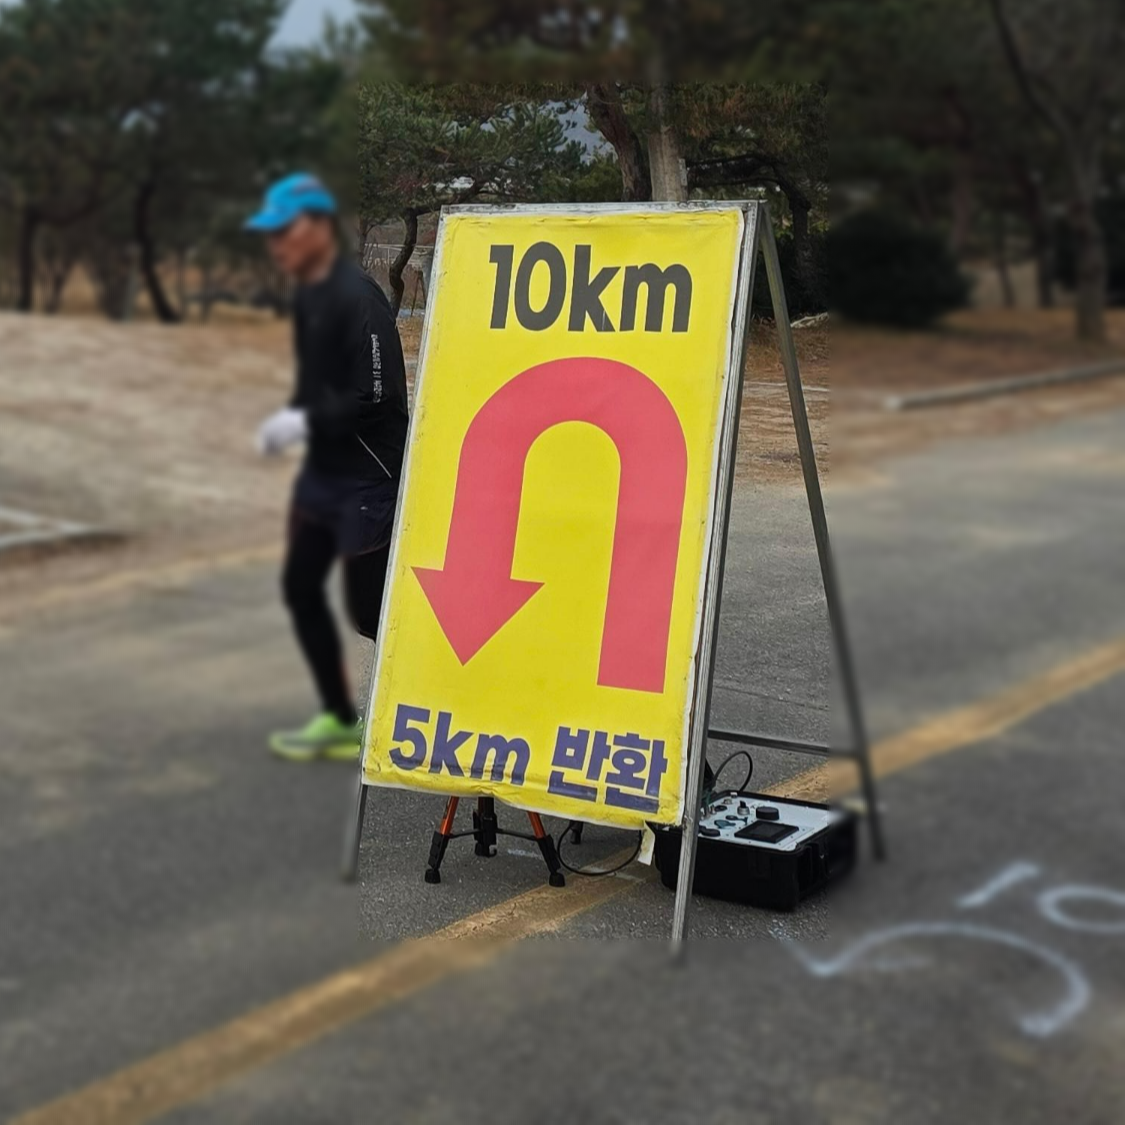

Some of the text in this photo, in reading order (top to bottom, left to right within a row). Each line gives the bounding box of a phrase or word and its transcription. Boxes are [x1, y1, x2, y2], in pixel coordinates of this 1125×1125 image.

[489, 241, 693, 334] 10km
[388, 703, 668, 815] 5km 반환
